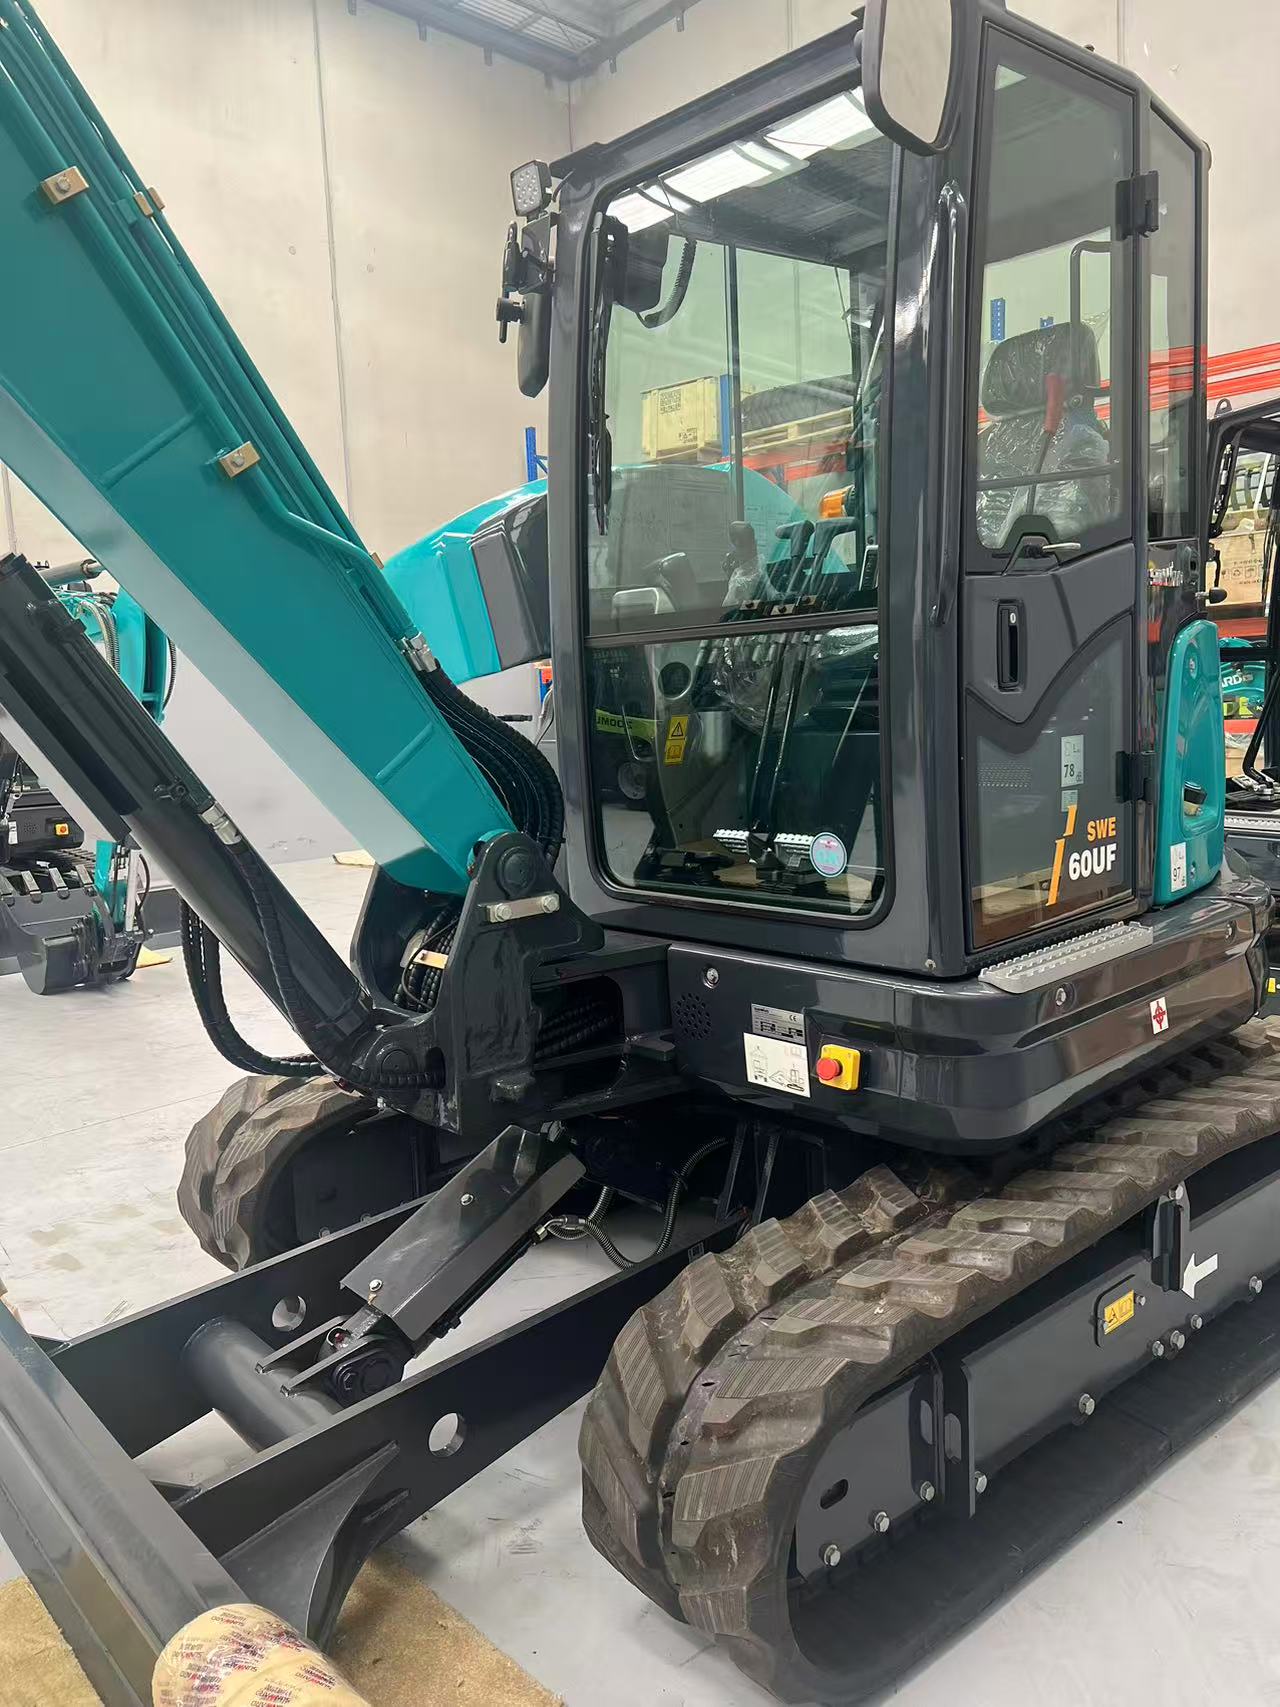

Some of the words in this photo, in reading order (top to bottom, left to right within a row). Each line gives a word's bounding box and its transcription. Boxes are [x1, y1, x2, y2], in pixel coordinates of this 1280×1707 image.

[1064, 763, 1075, 778] 78
[1087, 816, 1117, 842] SWE
[1068, 843, 1117, 881] 60UF
[1173, 866, 1181, 882] 97
